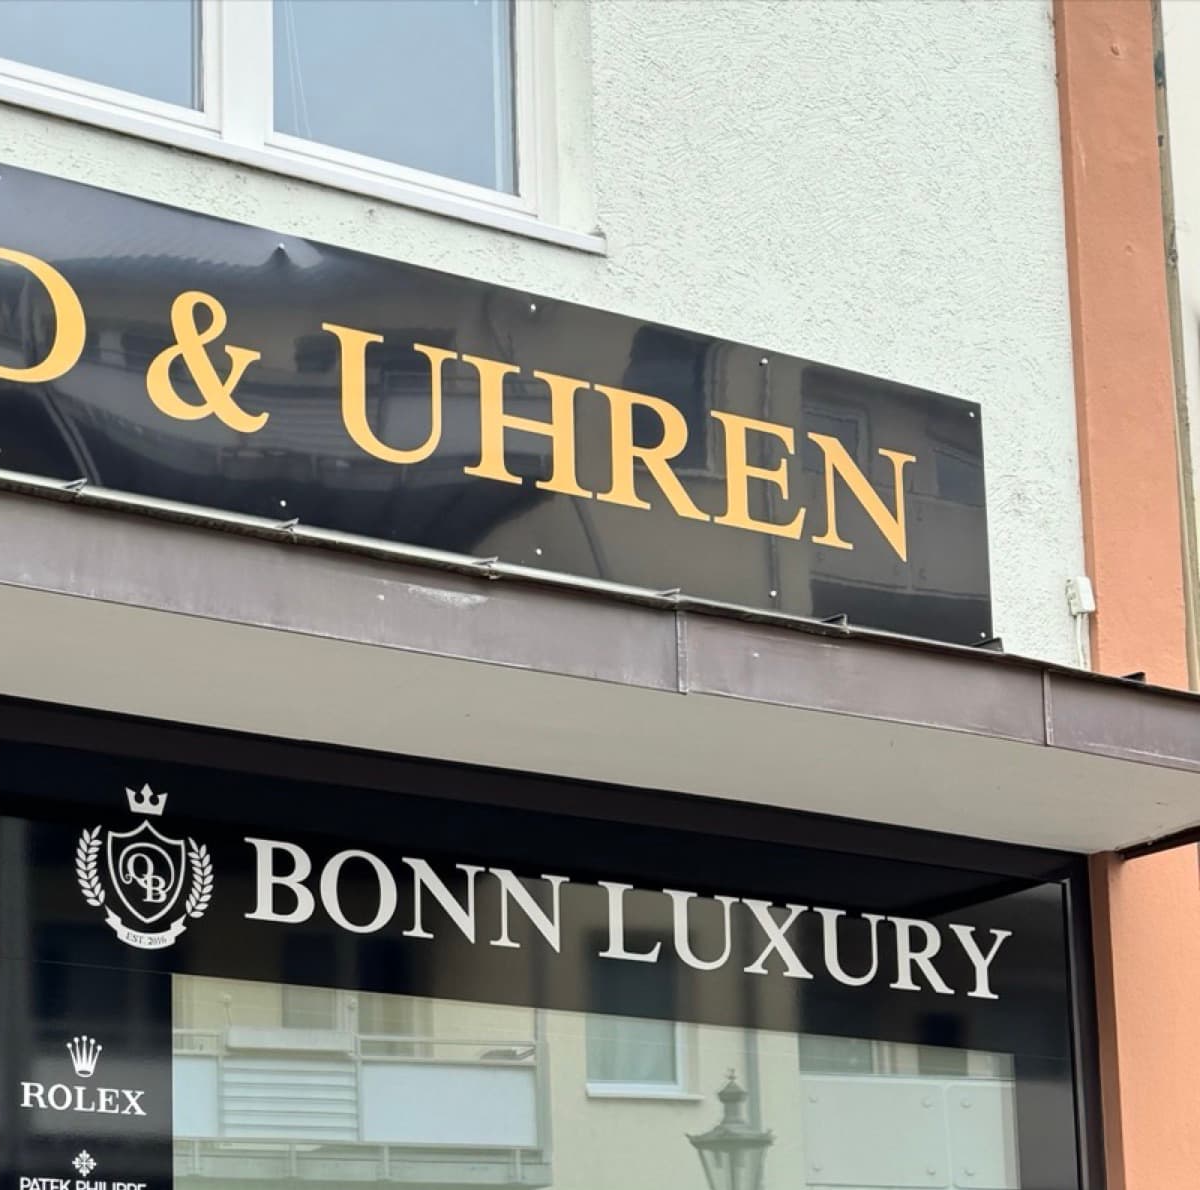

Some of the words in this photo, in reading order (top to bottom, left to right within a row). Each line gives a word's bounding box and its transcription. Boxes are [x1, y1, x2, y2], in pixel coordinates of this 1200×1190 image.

[146, 291, 268, 433] &
[322, 322, 916, 564] UHREN
[244, 837, 570, 953] BONN
[598, 881, 1012, 1000] LUXURY
[20, 1082, 147, 1116] ROLEX
